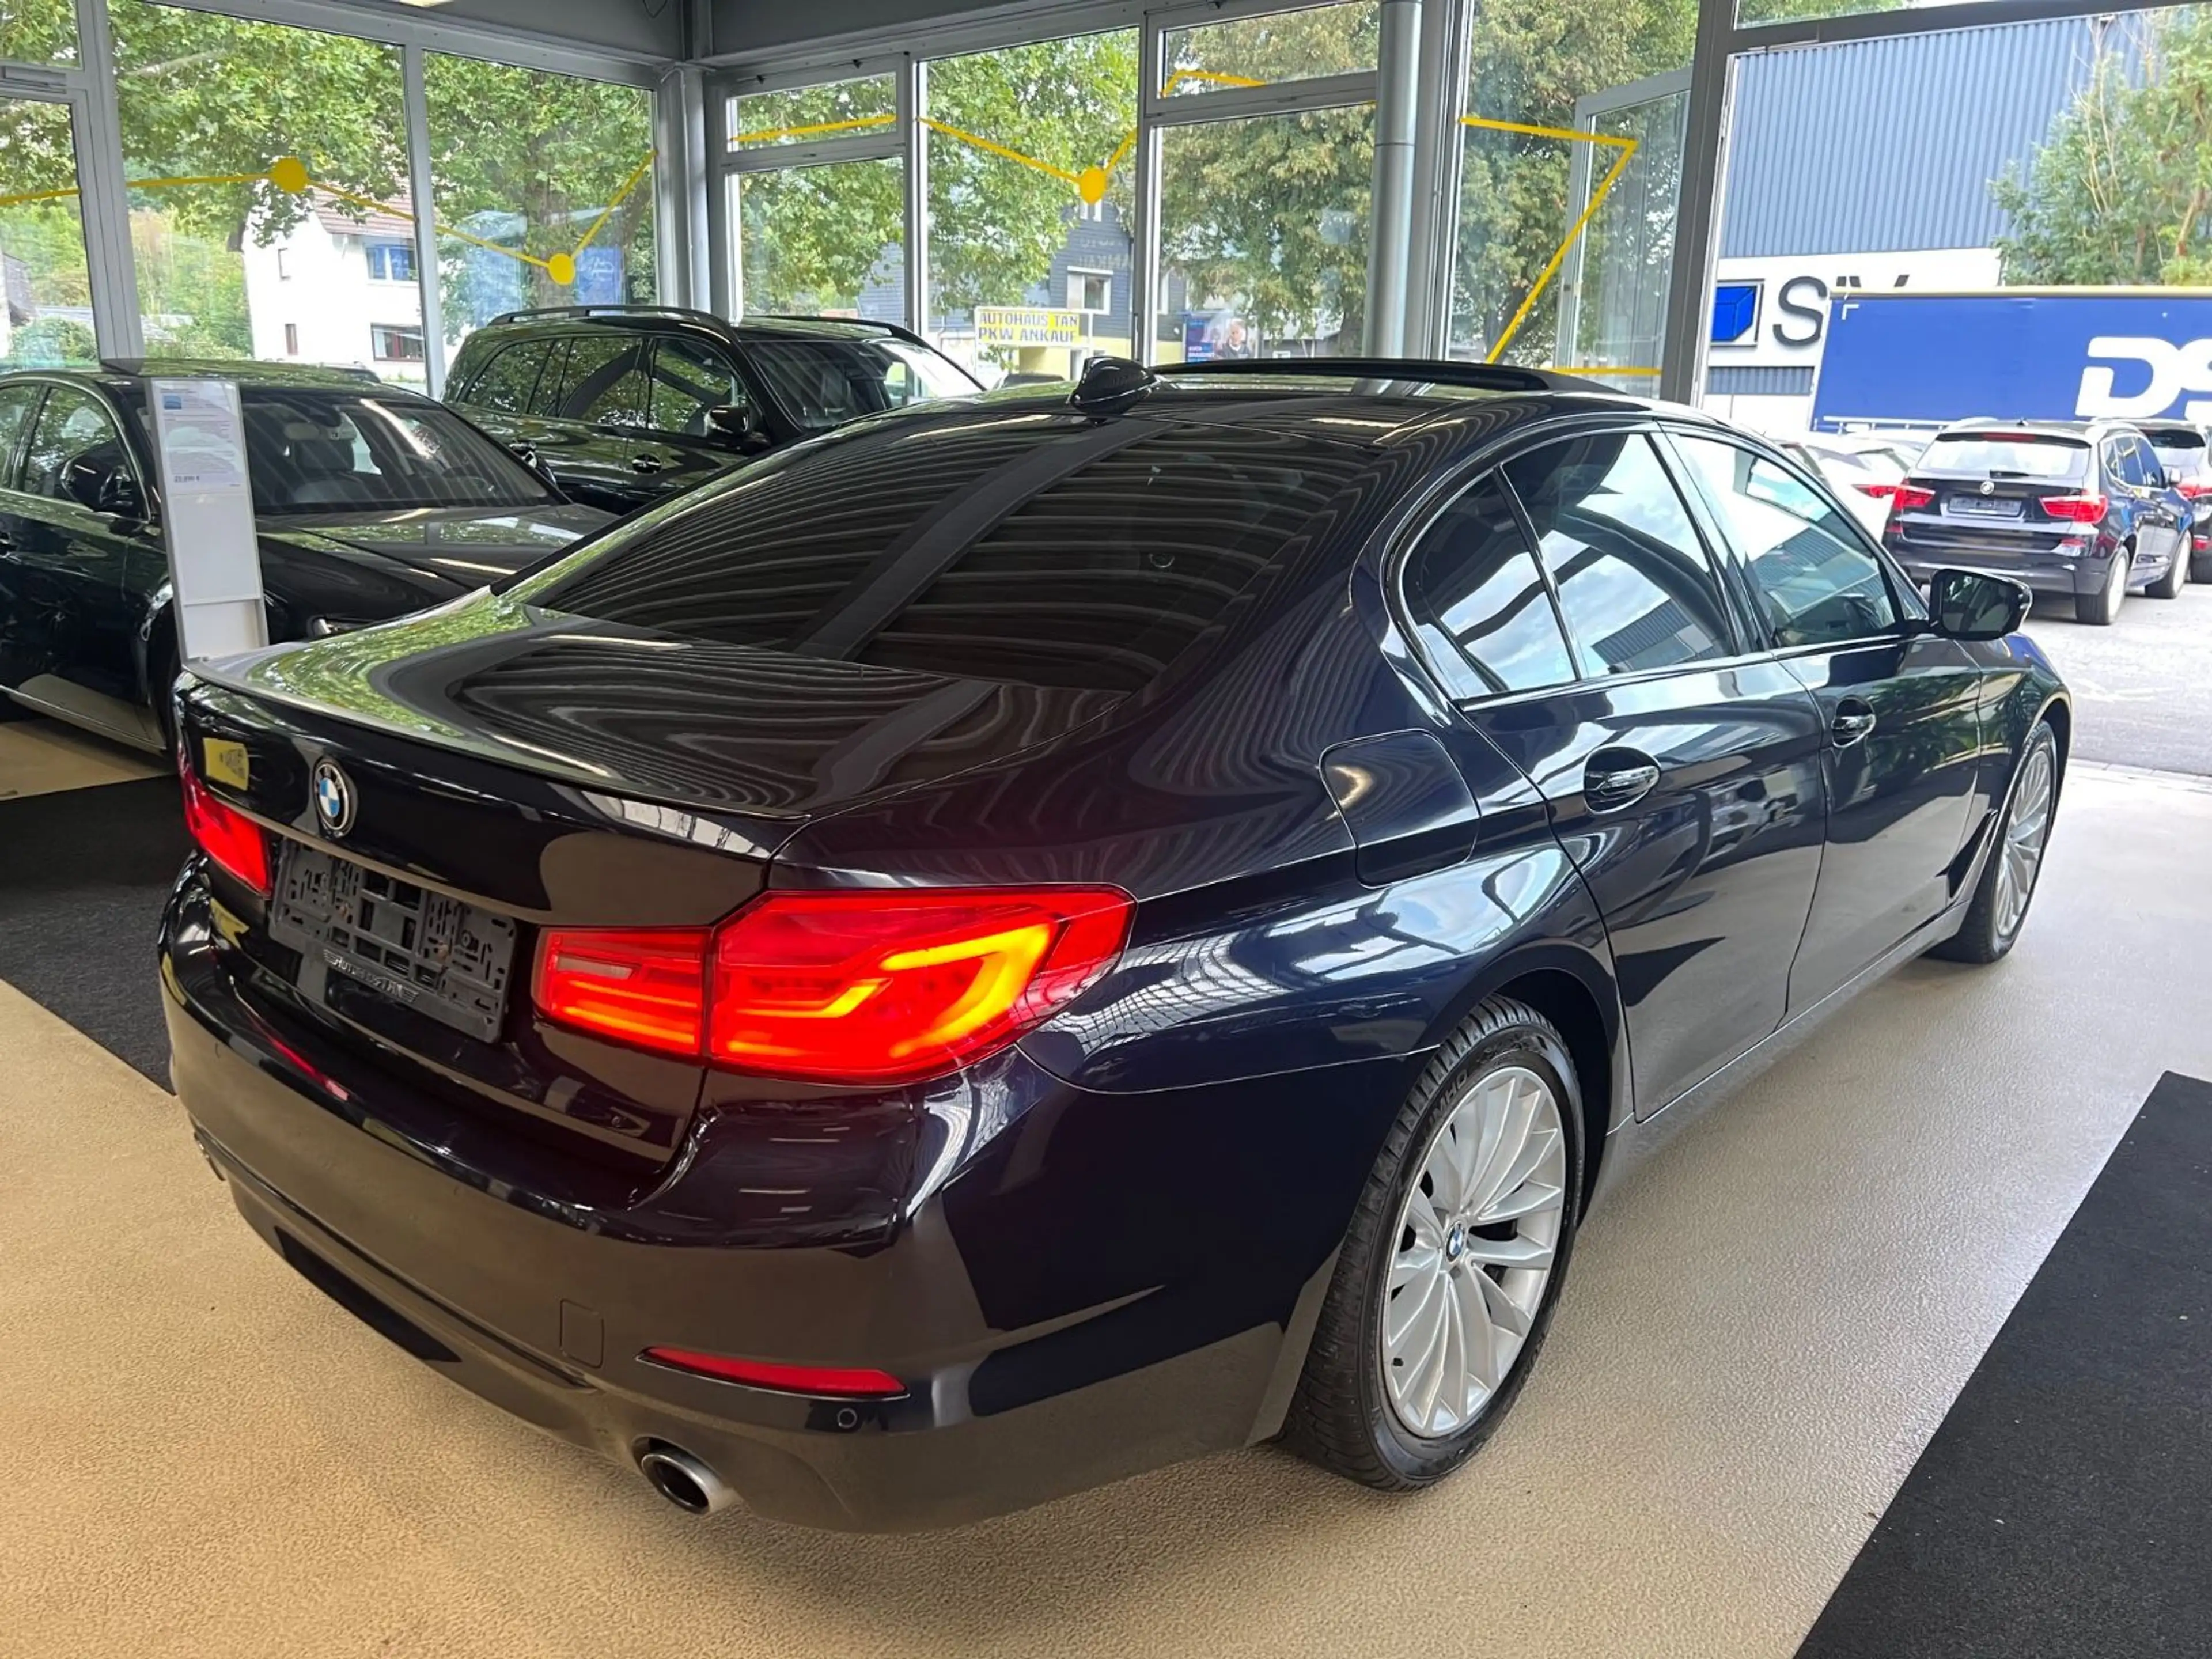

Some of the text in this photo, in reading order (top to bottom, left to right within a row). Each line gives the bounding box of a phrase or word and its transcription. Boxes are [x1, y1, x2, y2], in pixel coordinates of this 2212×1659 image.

[980, 312, 1078, 327] AUTOHAUS TAN
[979, 327, 1077, 342] PKW ANKAUF
